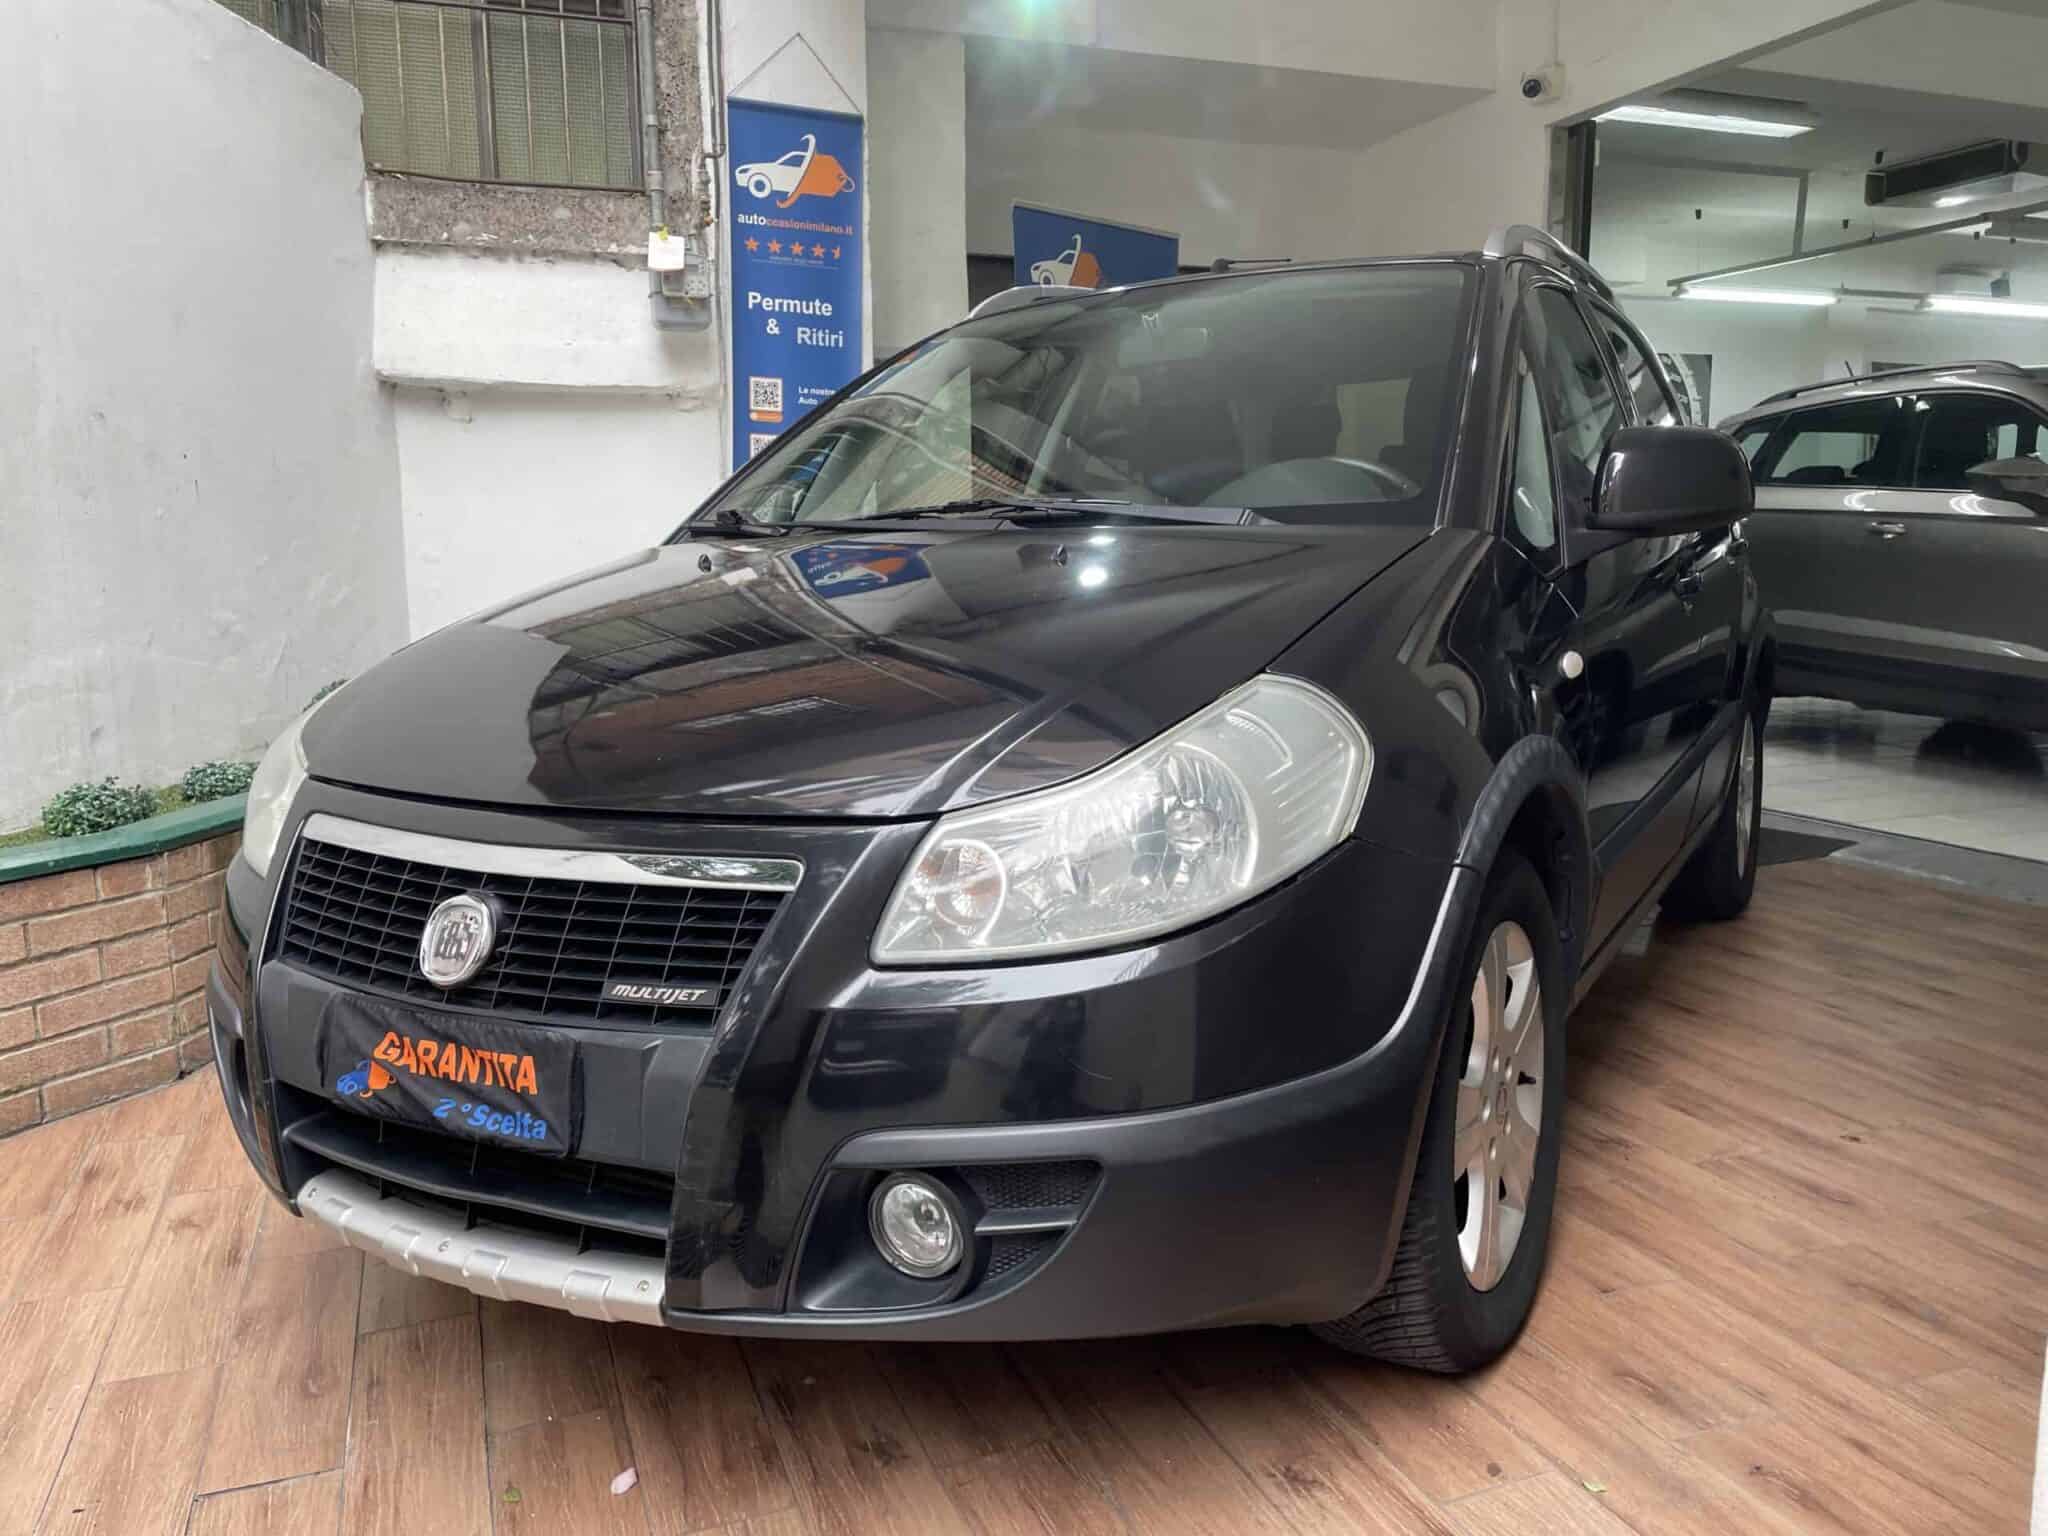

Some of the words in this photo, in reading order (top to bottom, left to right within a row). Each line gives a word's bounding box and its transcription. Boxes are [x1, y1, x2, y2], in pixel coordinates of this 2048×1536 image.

[748, 291, 833, 316] Permute
[766, 318, 781, 335] &
[797, 327, 844, 348] Ritiri
[611, 983, 707, 1004] MULTIJET
[372, 1031, 538, 1096] GARANTITA
[467, 1104, 547, 1140] Scelta
